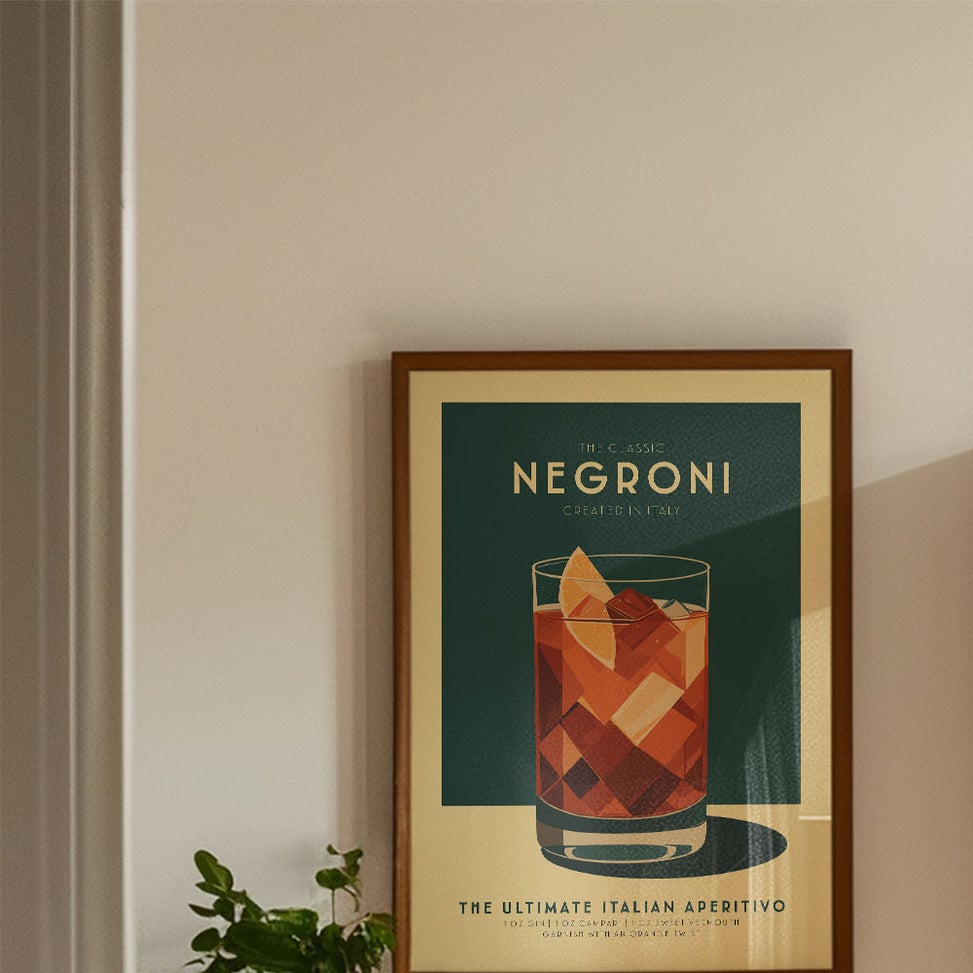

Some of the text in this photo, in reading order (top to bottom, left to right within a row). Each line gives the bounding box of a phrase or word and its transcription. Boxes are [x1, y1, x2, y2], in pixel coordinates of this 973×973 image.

[579, 443, 602, 453] THE
[513, 461, 730, 494] NEGRONI
[562, 505, 681, 516] CREATED IN ITALY
[459, 899, 786, 914] THE ULTIMATE ITALIAN APERITIVO
[578, 919, 621, 927] CAMPAR
